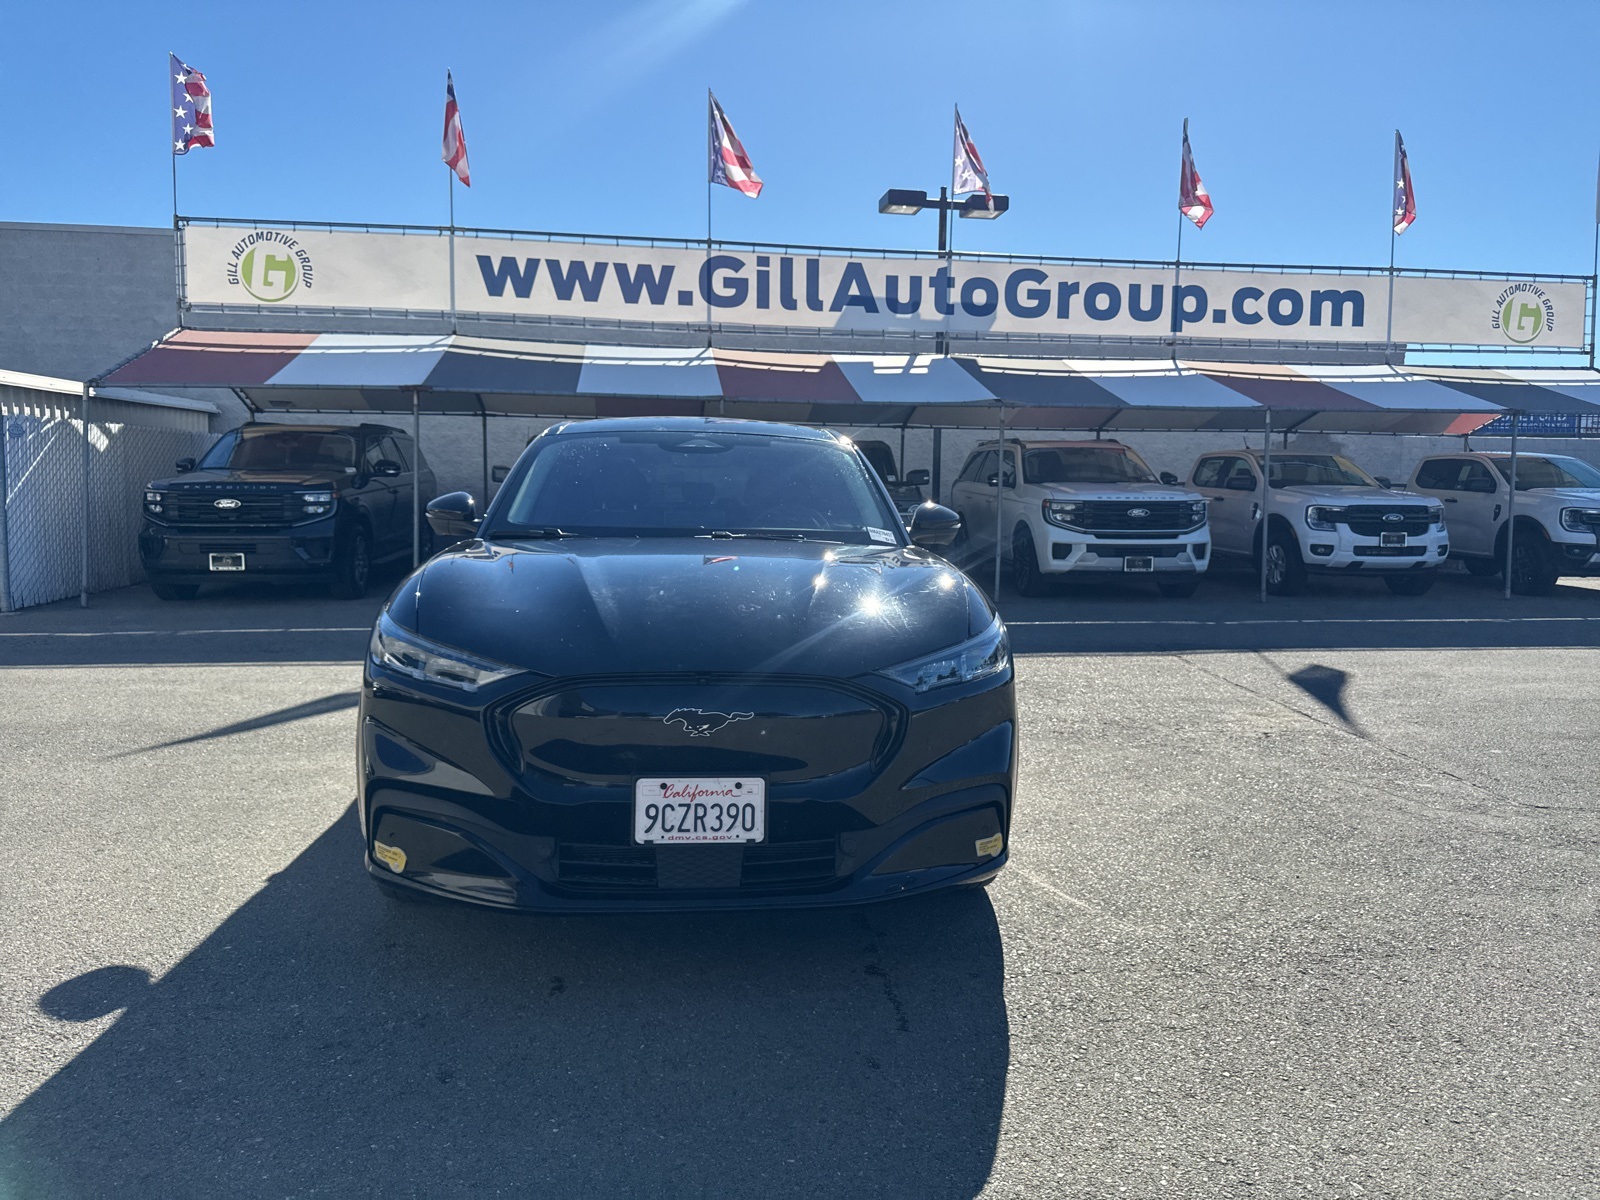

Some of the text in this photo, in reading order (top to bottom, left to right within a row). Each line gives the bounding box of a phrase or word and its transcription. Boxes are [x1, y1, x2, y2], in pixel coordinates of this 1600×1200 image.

[226, 230, 314, 289] GILL AUTOMOTIVE GROUP
[475, 254, 1365, 333] www.GillAutoGroup.com
[1491, 283, 1555, 332] GILL AUTOMOTIVE GROUP
[663, 784, 741, 802] California
[644, 803, 756, 833] 9CZR390
